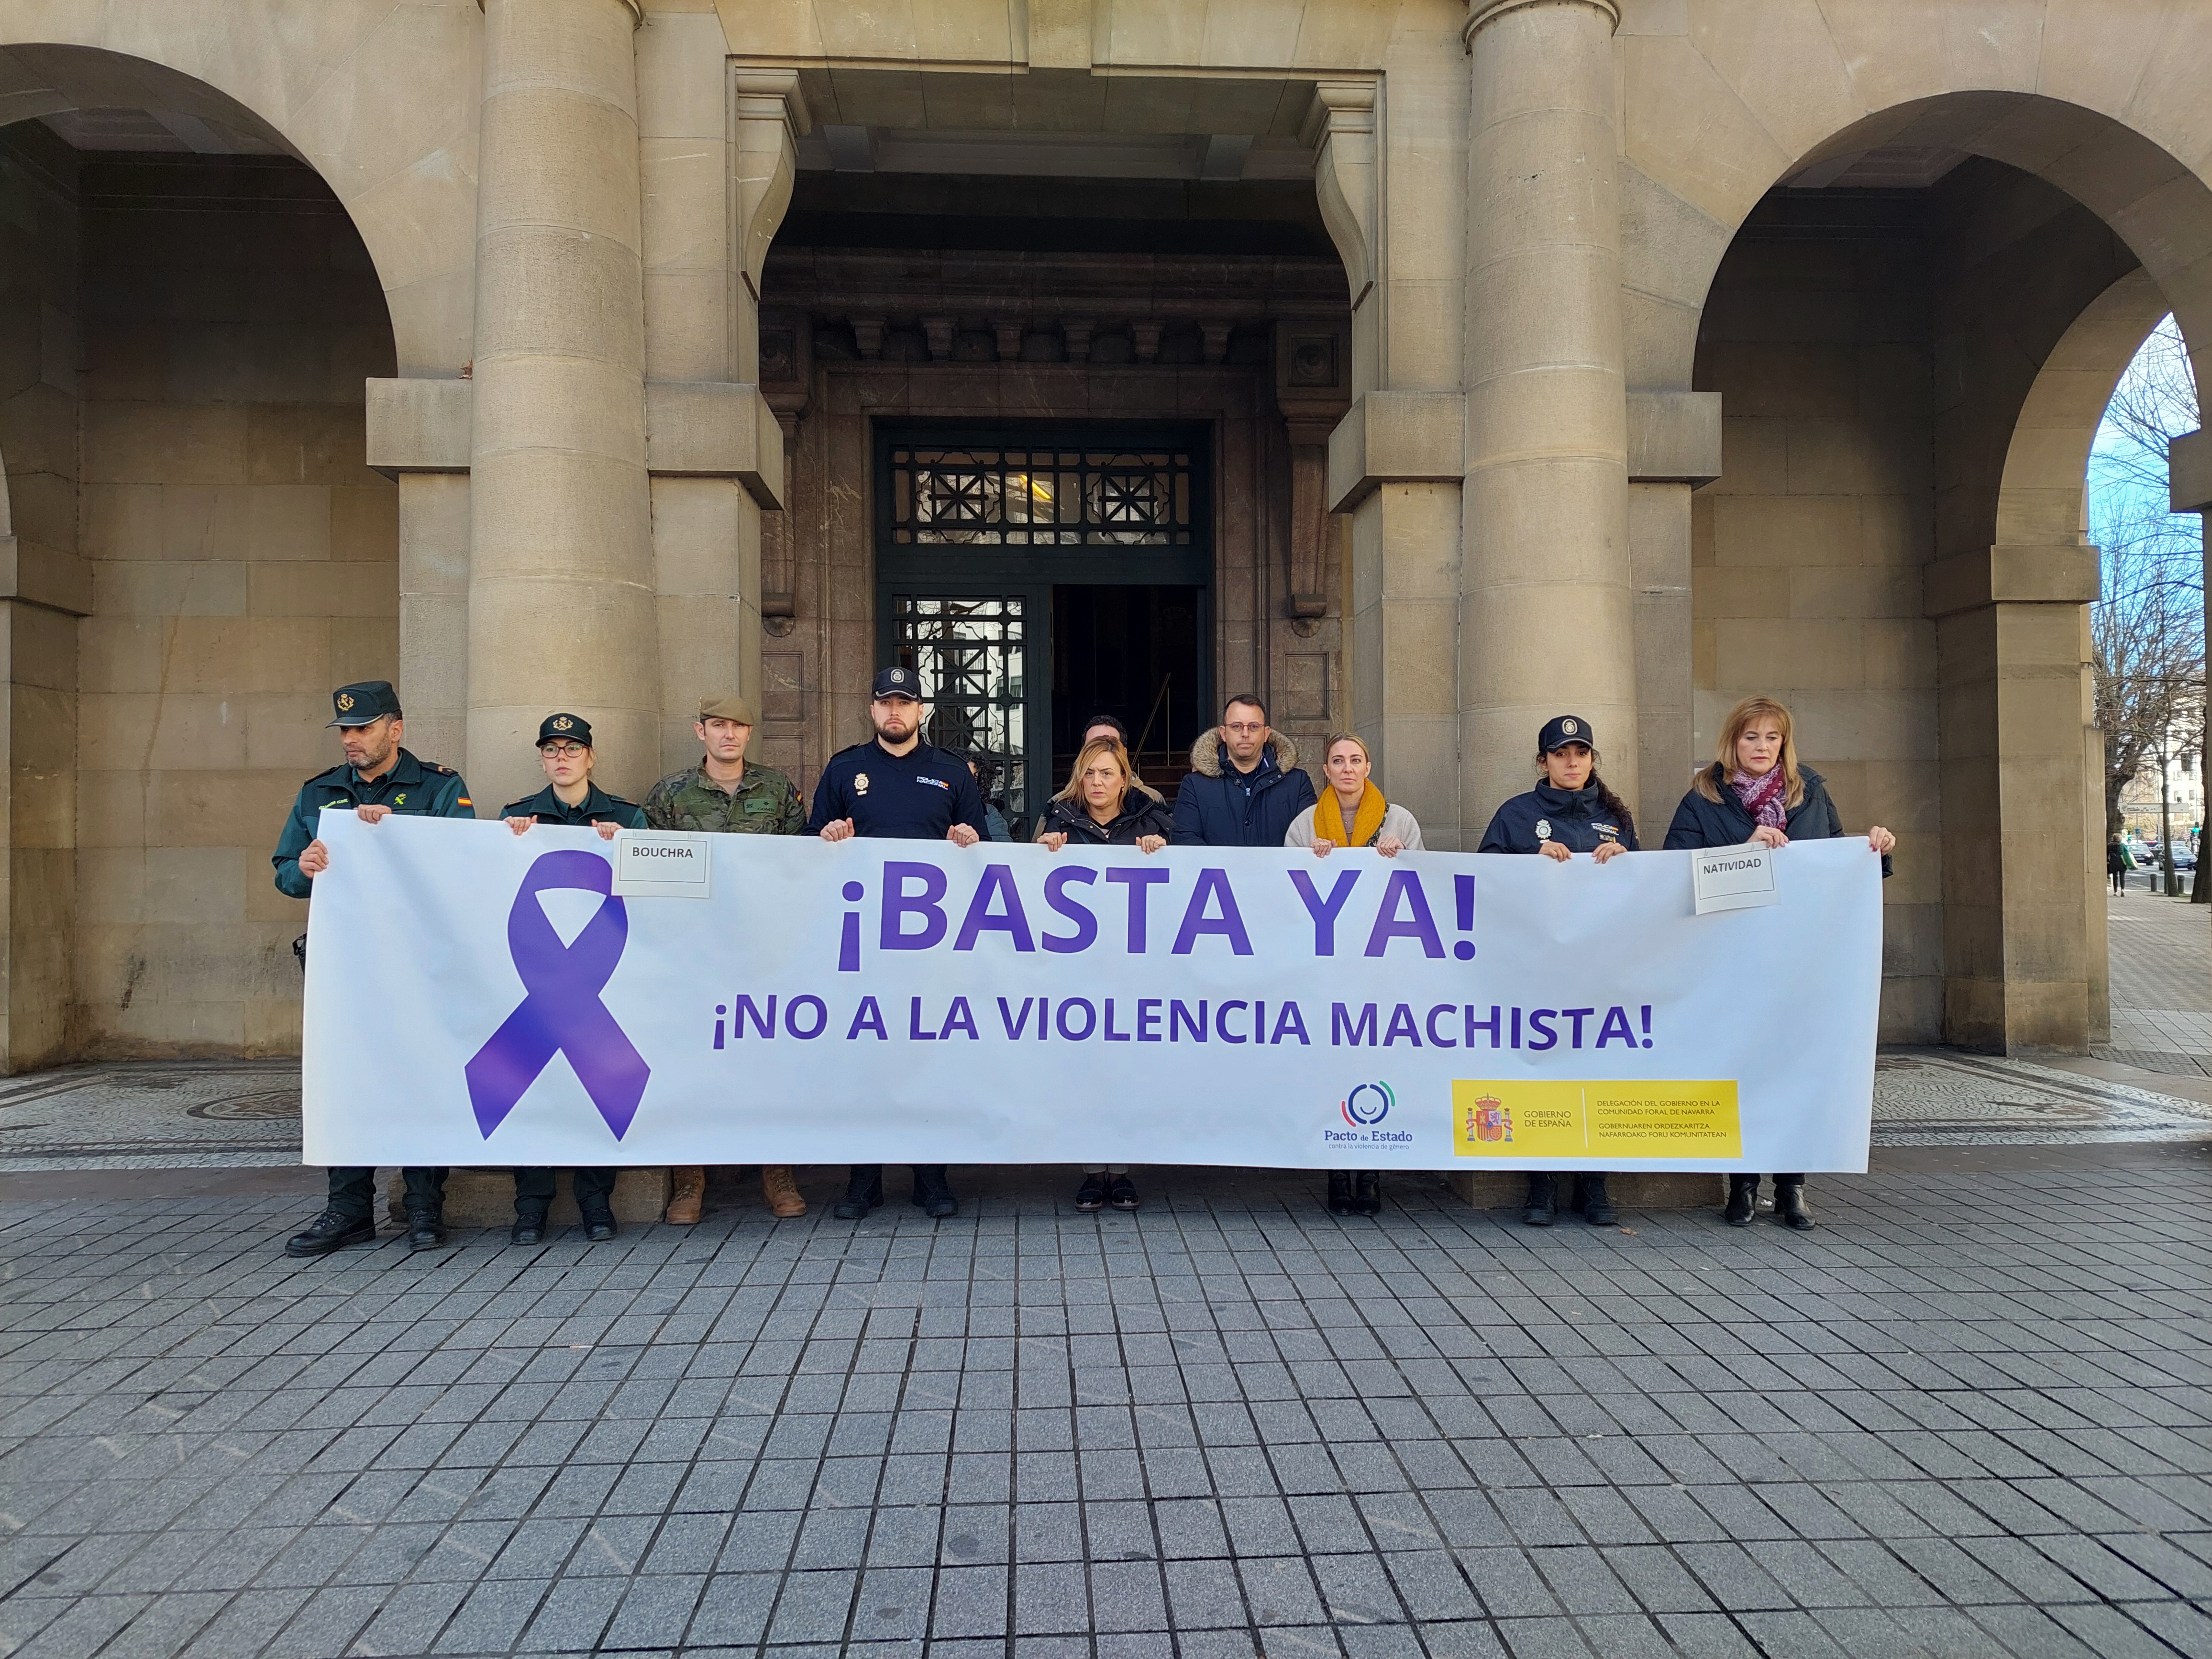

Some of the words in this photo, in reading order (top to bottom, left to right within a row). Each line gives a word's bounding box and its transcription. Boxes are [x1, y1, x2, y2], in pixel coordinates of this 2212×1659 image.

[917, 779, 948, 790] NACIONAL
[632, 847, 693, 858] BOUCHRA
[1703, 858, 1762, 874] NATIVIDAD
[838, 862, 1254, 972] ¡BASTA
[1287, 870, 1476, 961] YA!
[713, 995, 827, 1050] ¡NO
[846, 996, 888, 1040] A
[910, 996, 979, 1040] LA
[996, 997, 1310, 1045] VIOLENCIA
[1332, 1002, 1653, 1051] MACHISTA!
[1539, 1119, 1572, 1128] ESPAÑA
[1324, 1130, 1358, 1141] Pacto
[1371, 1130, 1413, 1142] Estado
